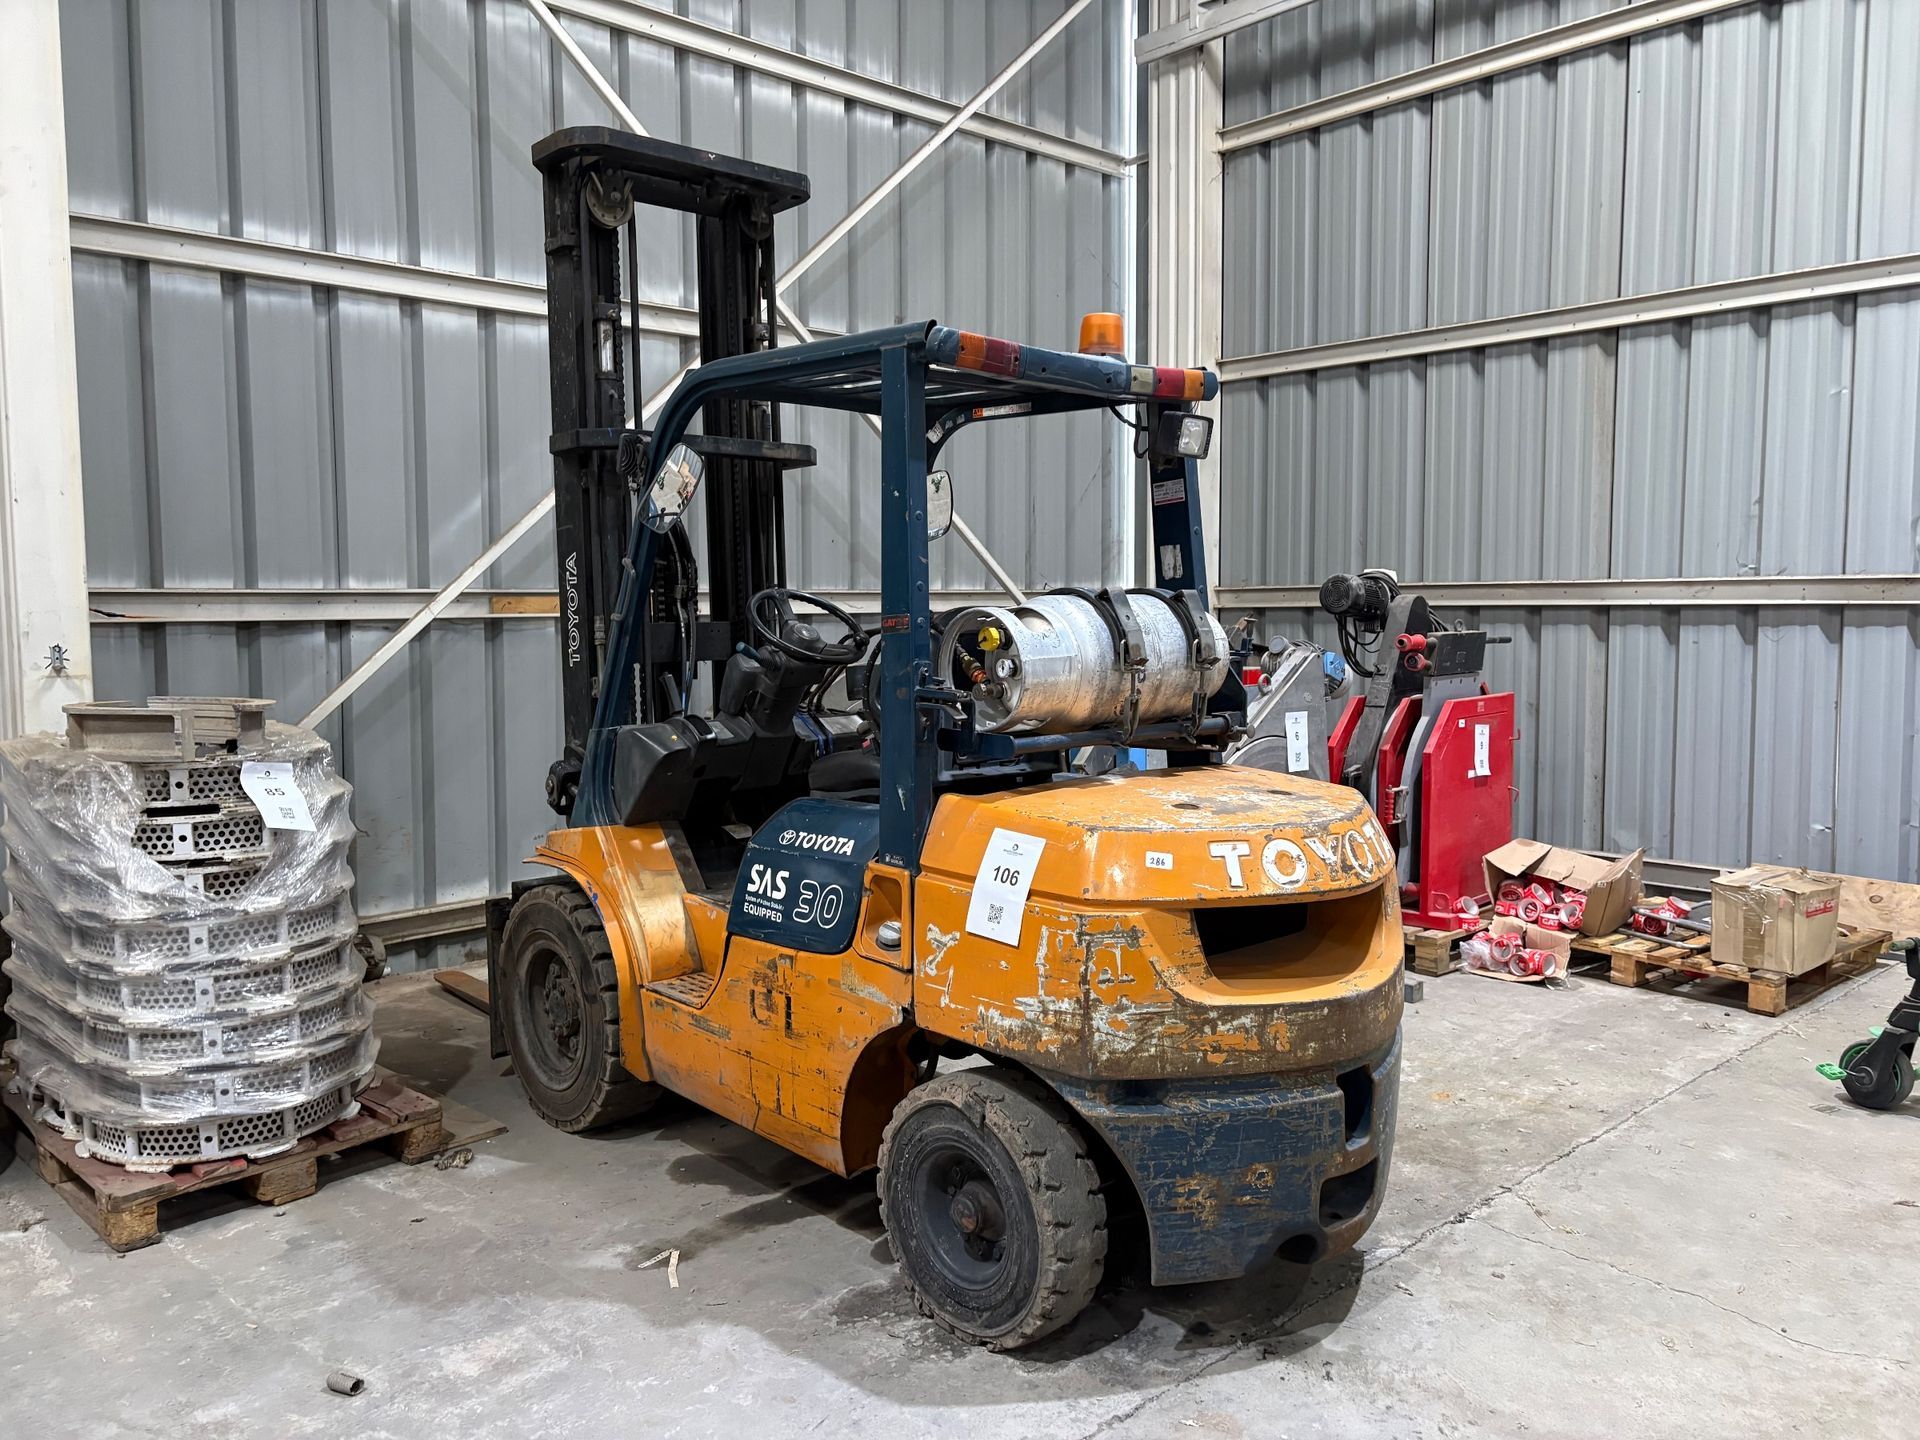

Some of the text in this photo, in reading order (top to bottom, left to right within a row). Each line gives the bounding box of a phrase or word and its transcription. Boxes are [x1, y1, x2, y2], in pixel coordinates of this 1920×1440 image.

[565, 551, 580, 667] TOYOTA
[264, 787, 286, 796] 85
[795, 831, 855, 856] TOYOTA
[1149, 856, 1166, 867] 286
[747, 863, 790, 900] SAS
[993, 865, 1020, 887] 106
[743, 902, 783, 923] EQUIPPED
[792, 880, 844, 929] 30
